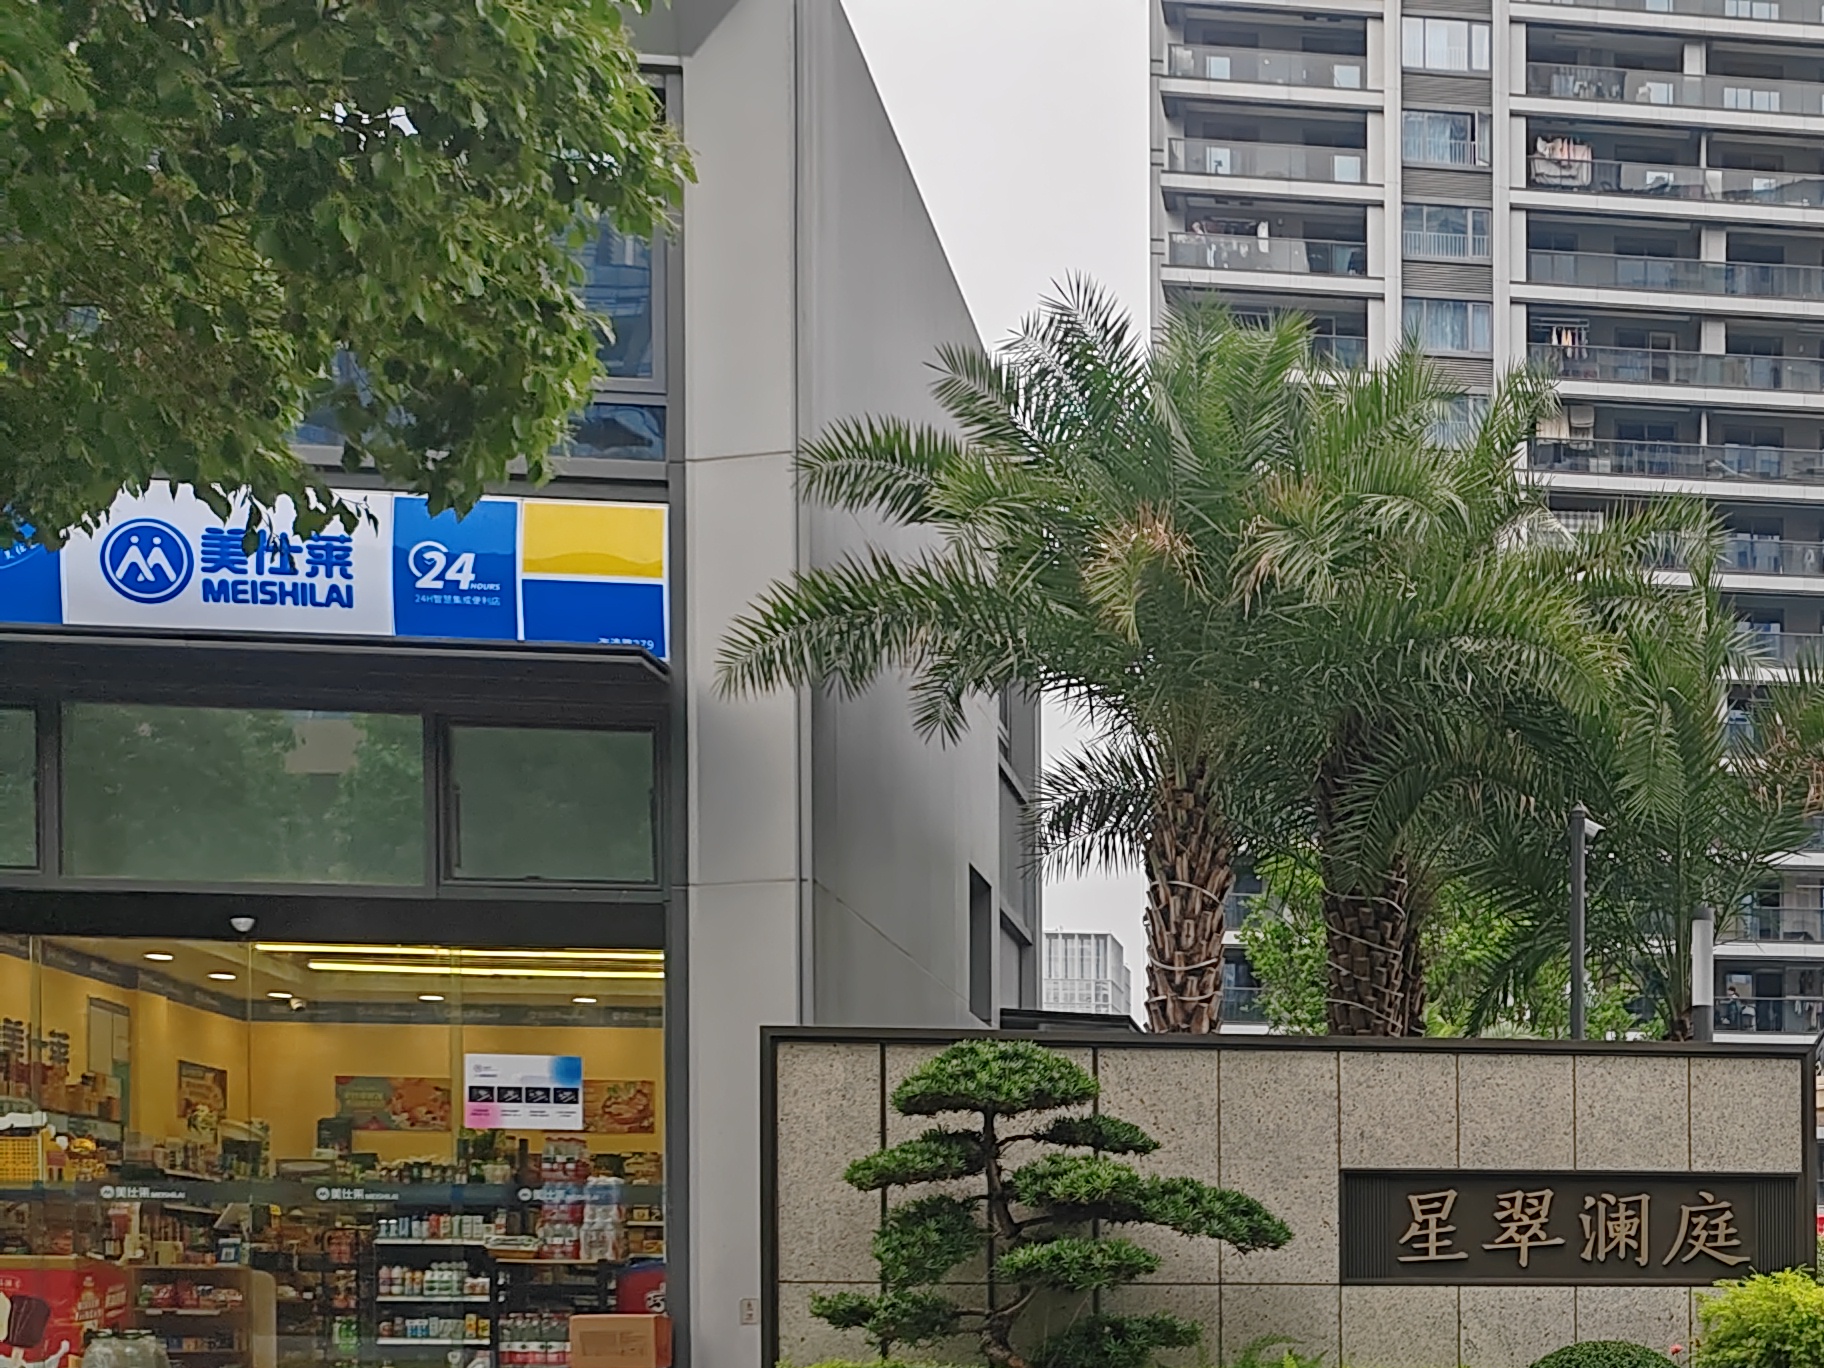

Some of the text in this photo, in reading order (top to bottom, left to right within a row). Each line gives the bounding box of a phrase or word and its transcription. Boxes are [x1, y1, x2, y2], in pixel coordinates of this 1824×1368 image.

[200, 527, 354, 580] 美仕莱
[412, 547, 501, 591] 24 HOURS
[202, 578, 354, 609] MEISHILAI
[1396, 1187, 1751, 1268] 星翠澜庭
